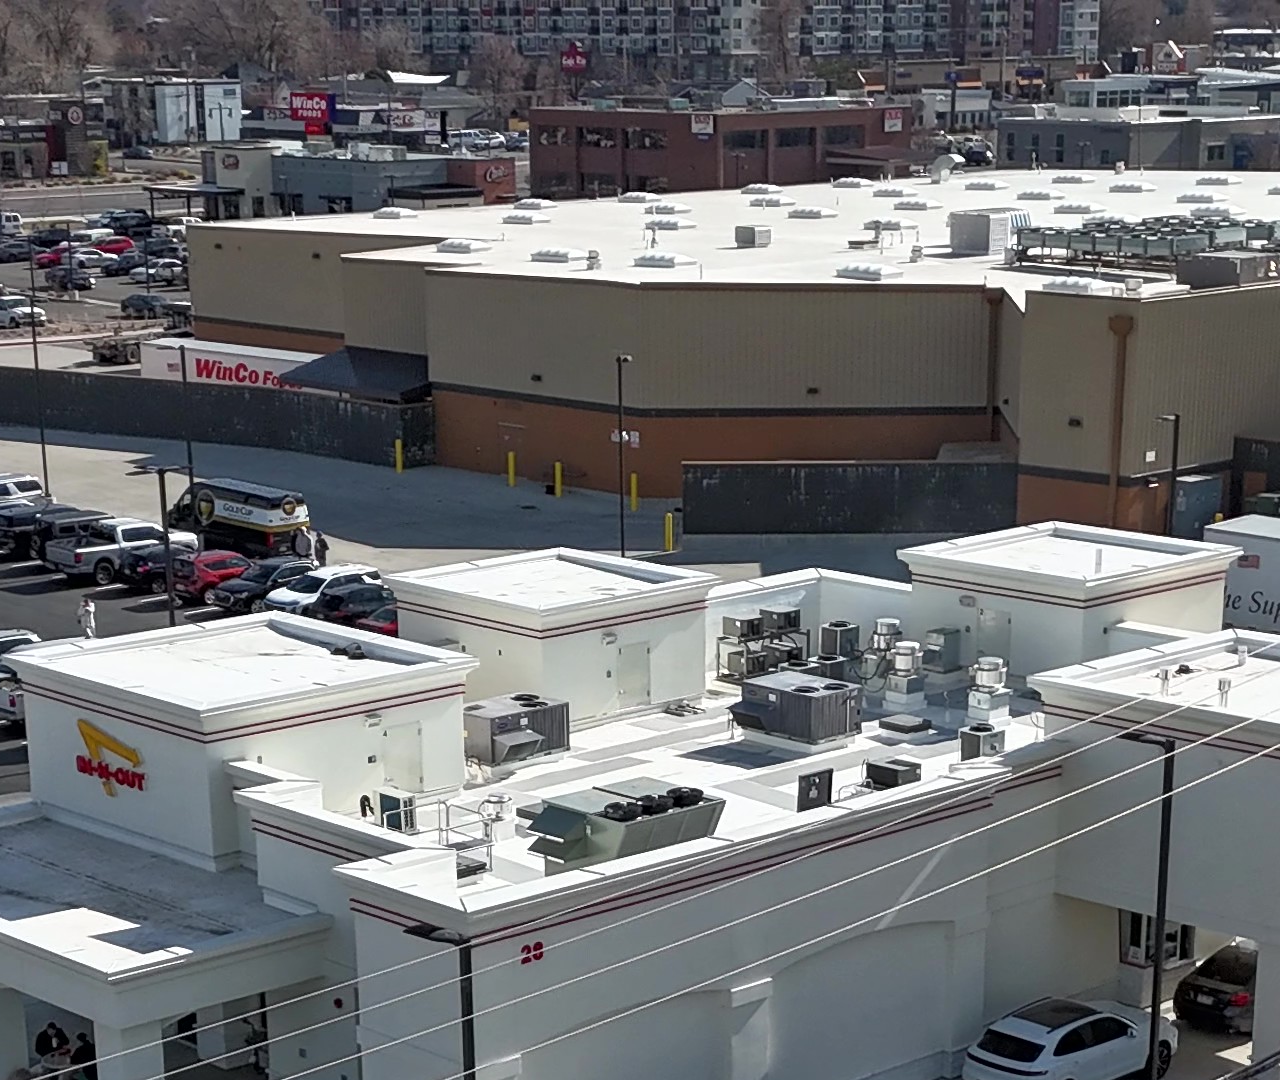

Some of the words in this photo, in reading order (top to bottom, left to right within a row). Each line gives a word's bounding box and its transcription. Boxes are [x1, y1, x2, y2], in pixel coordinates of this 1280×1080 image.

[292, 96, 327, 110] WinCo
[194, 357, 260, 385] WinCo
[76, 755, 145, 791] IN-N-OUT
